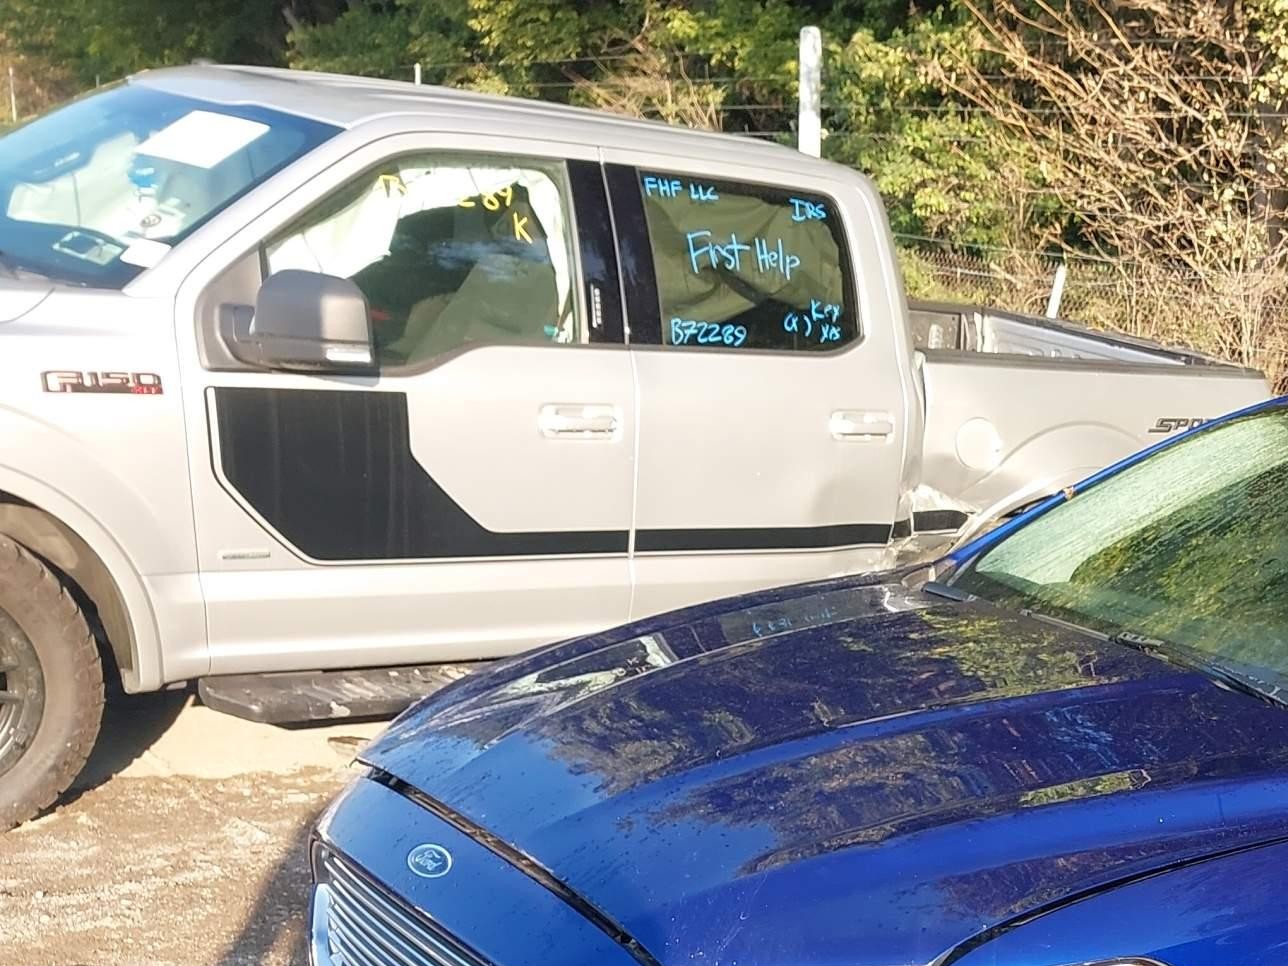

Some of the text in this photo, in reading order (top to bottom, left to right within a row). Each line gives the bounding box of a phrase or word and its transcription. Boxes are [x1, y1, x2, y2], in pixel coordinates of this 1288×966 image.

[644, 177, 720, 201] FHF LLC
[513, 211, 534, 245] K
[686, 230, 801, 281] First Help
[671, 317, 748, 347] B72289
